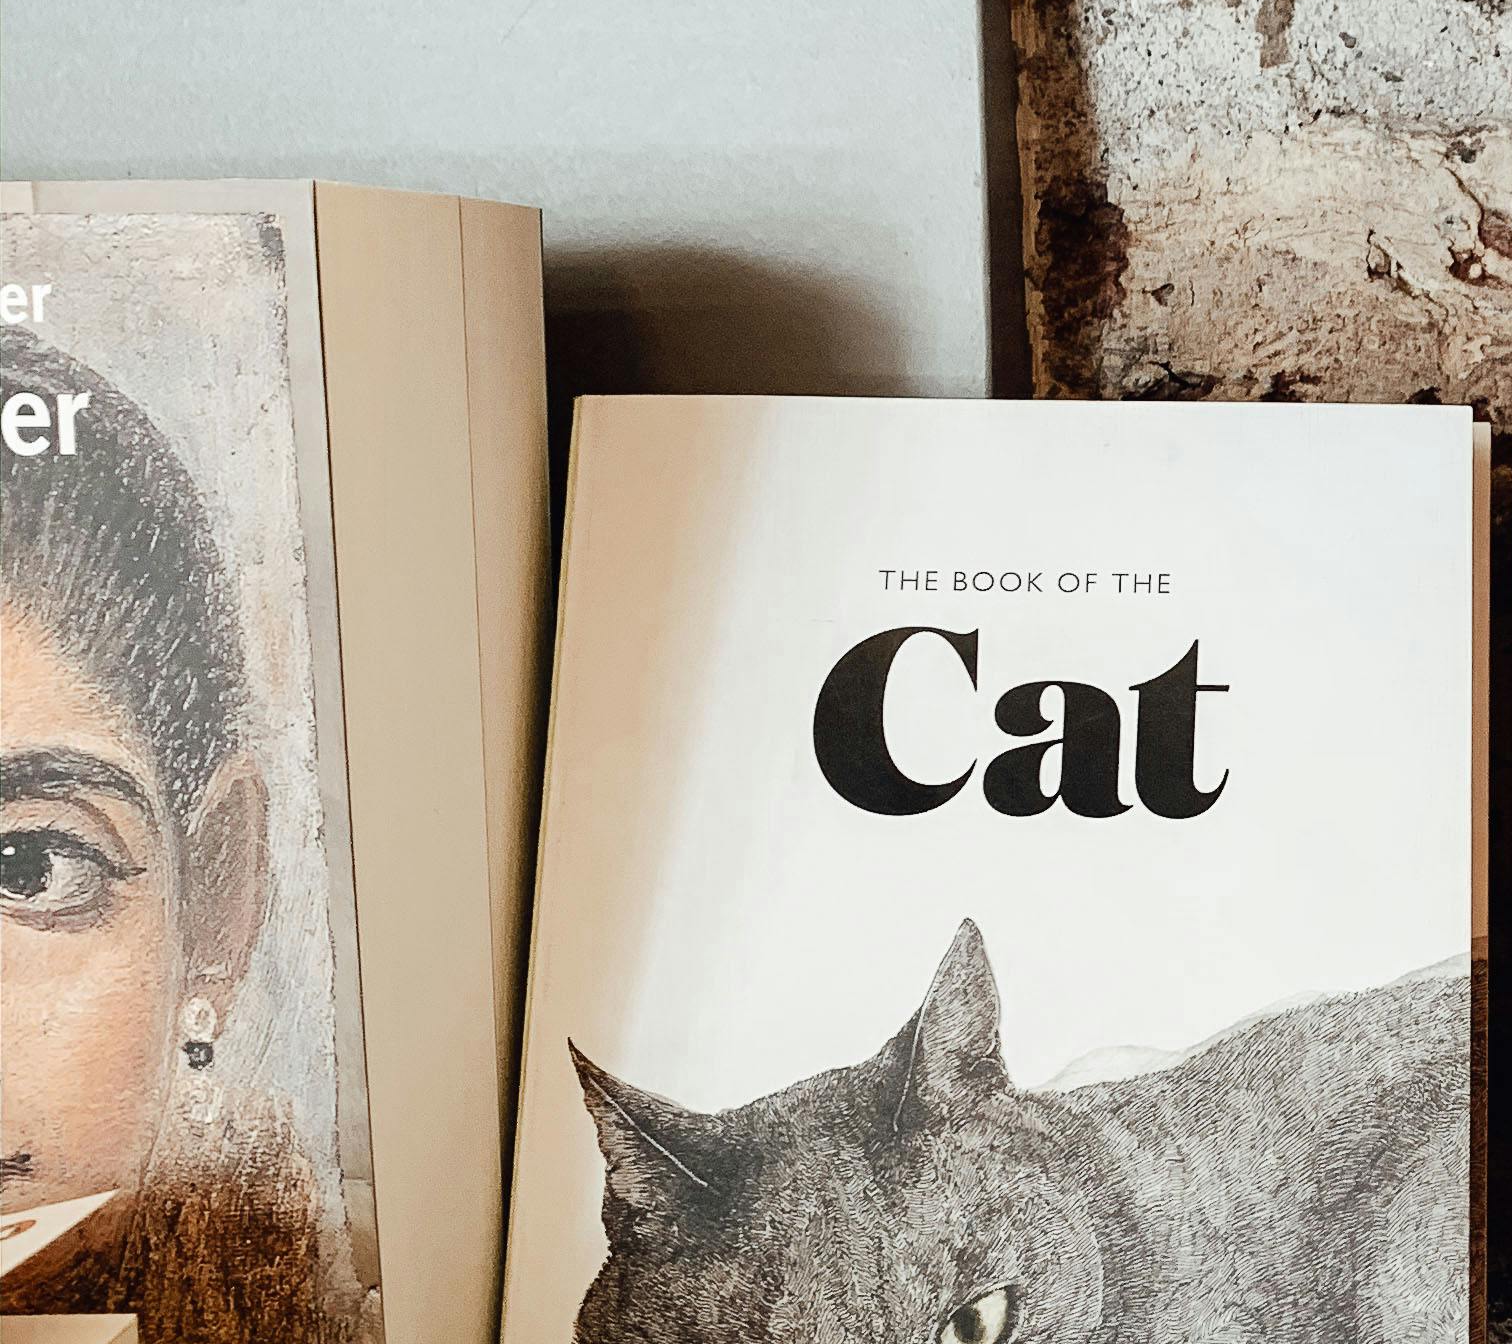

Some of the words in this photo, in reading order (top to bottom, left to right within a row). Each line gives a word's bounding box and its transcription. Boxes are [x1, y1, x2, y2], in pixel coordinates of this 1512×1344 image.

[1, 391, 92, 456] er
[878, 568, 939, 592] THE
[952, 570, 1044, 594] BOOK
[1057, 571, 1098, 594] OF
[1111, 572, 1172, 595] THE
[812, 625, 1230, 820] Cat
